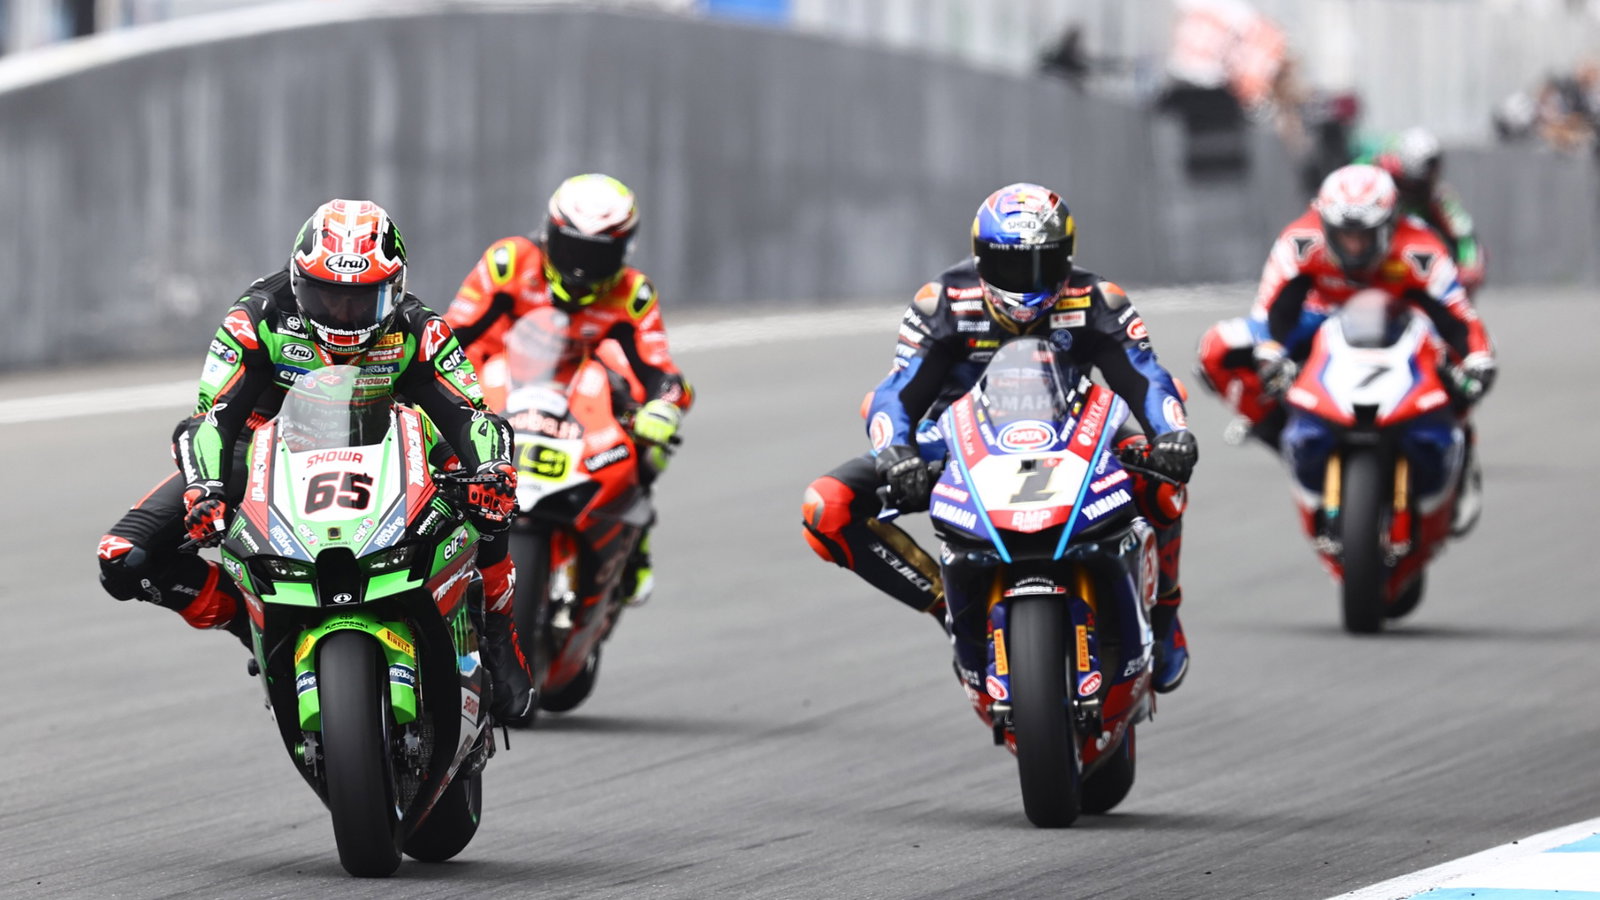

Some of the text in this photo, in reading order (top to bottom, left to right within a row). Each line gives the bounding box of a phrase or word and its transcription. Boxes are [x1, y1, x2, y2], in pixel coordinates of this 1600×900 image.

[330, 256, 364, 268] Arai
[310, 319, 381, 336] www.jonathan-rea.com
[209, 339, 228, 356] elf
[289, 345, 310, 359] Arai
[325, 342, 361, 352] Medallia
[442, 348, 462, 371] elf
[354, 377, 390, 386] SHOWA
[1356, 365, 1392, 389] 7
[1011, 430, 1043, 443] PATA
[306, 451, 363, 468] SHOWA
[1008, 458, 1057, 504] 1
[304, 471, 374, 515] 65
[1081, 488, 1132, 520] YAMAHA
[416, 510, 439, 536] MONSTER
[931, 501, 977, 530] YAMAHA
[1012, 510, 1052, 527] BMP
[444, 535, 461, 560] elf
[386, 630, 411, 653] PIRELLI
